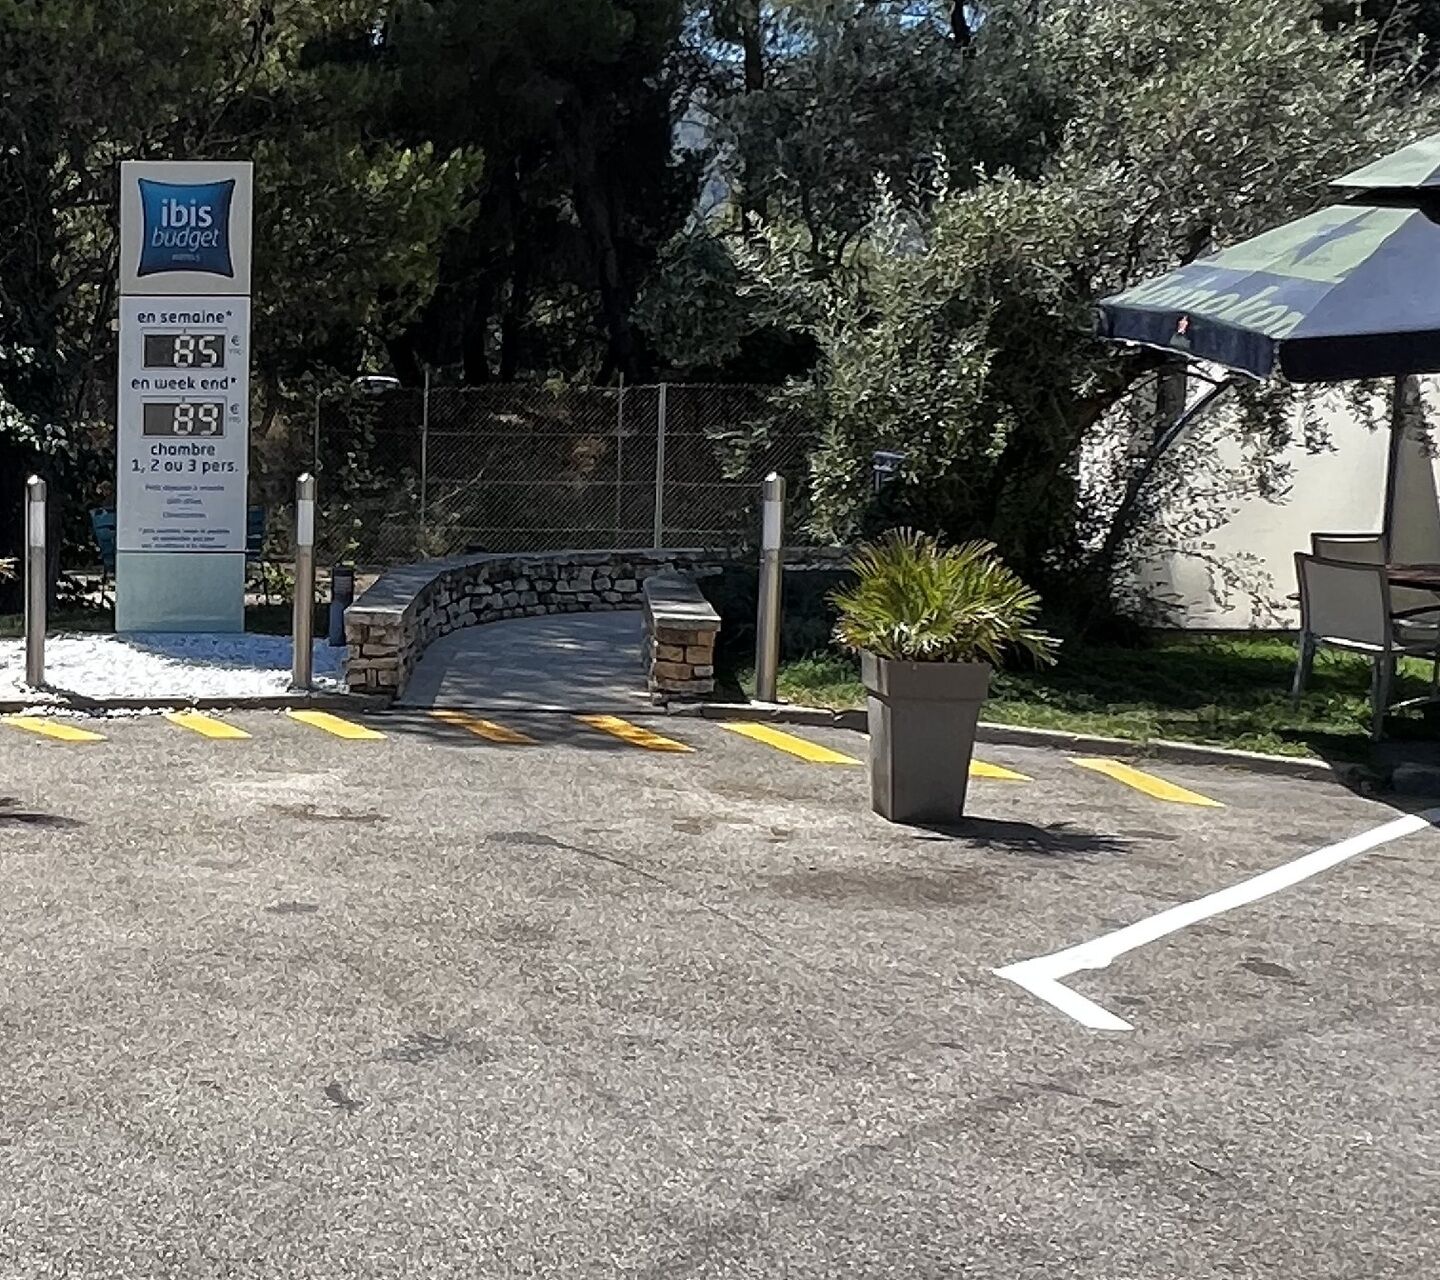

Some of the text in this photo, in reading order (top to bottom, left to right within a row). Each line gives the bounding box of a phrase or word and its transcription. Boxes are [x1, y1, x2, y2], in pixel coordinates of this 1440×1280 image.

[161, 198, 213, 228] ibis
[151, 226, 219, 252] budget
[137, 312, 156, 323] en
[173, 335, 217, 368] 85
[131, 378, 150, 390] en
[154, 376, 196, 390] week
[173, 404, 219, 436] 89
[150, 442, 216, 456] chambre
[131, 458, 239, 475] 1, 2 ou 3 pers.
